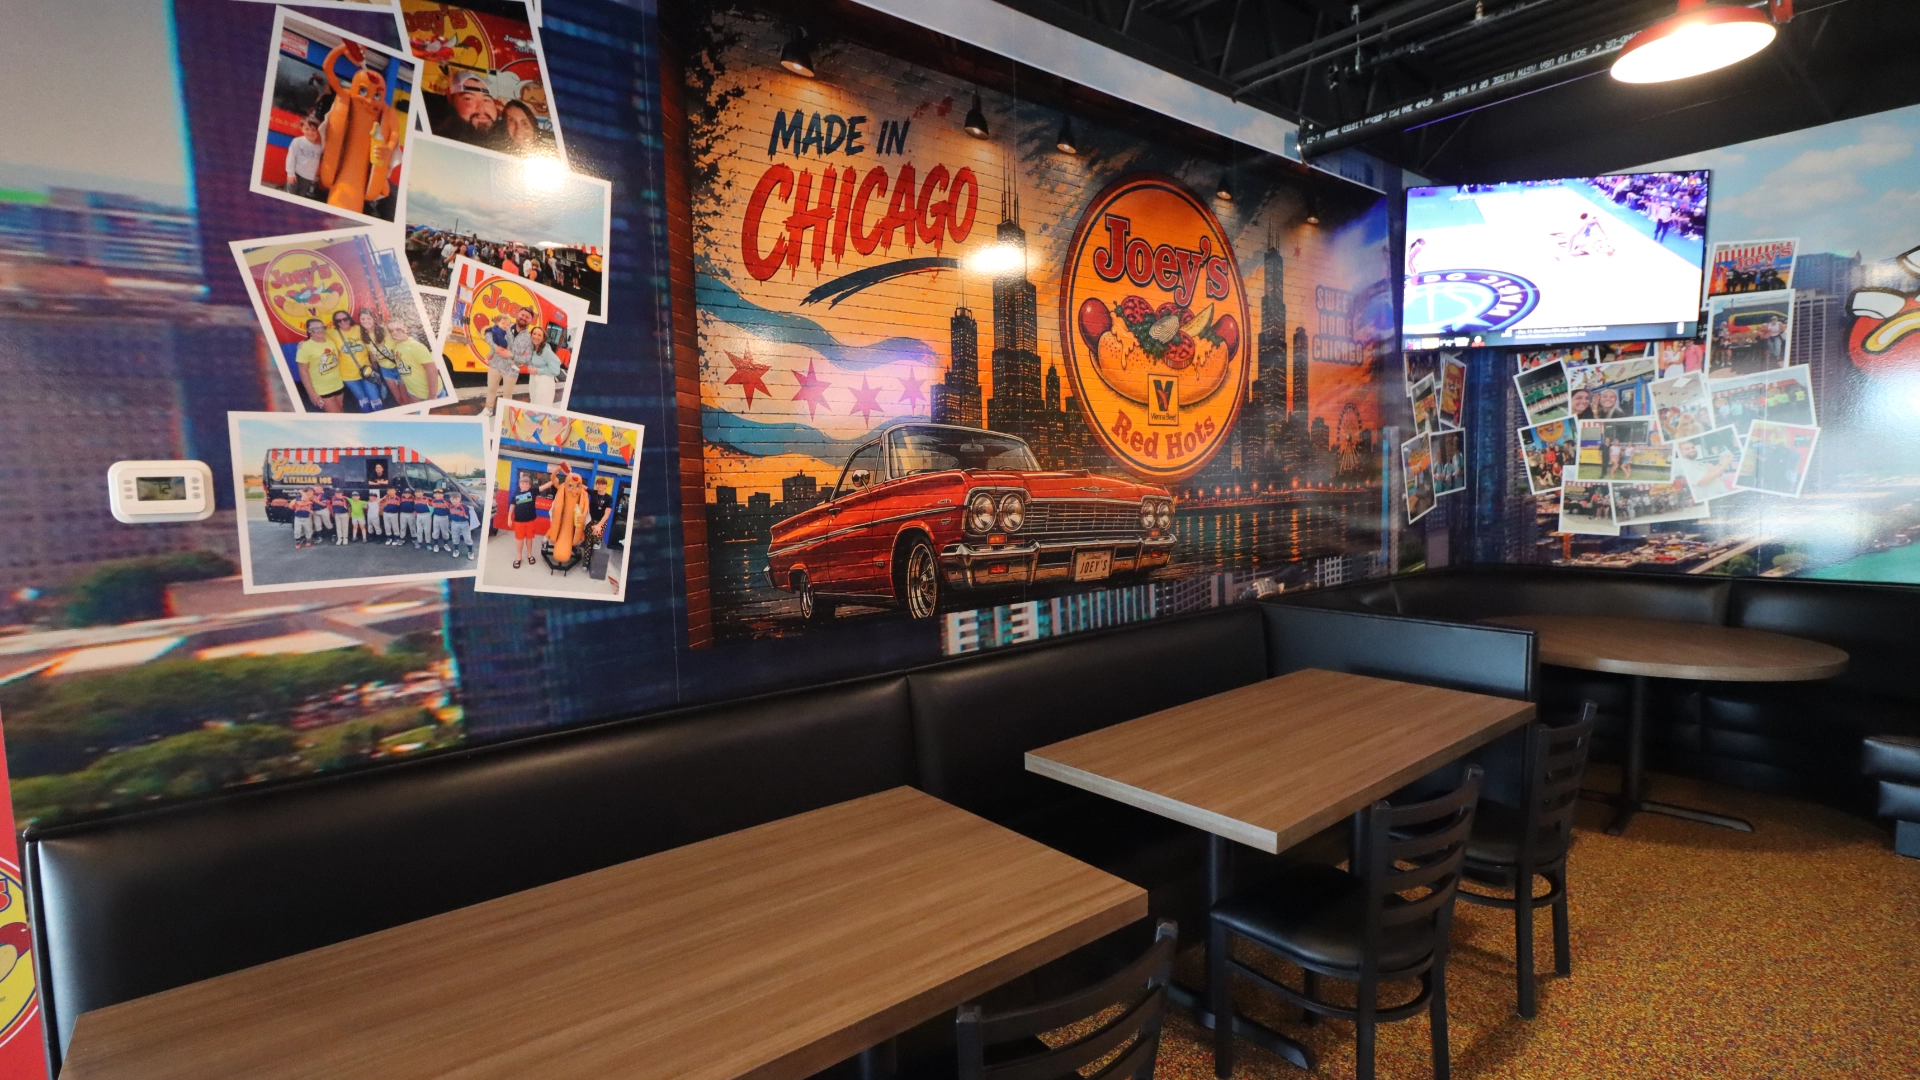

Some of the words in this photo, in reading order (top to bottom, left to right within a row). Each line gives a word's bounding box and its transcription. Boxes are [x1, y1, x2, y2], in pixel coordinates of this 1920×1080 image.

[404, 5, 468, 36] oey's
[1540, 58, 1554, 69] USA
[1571, 47, 1586, 59] SCH
[768, 109, 867, 159] MADE
[877, 117, 911, 156] IN
[742, 161, 979, 285] CHICAGO
[1094, 213, 1230, 308] Joey's
[1733, 244, 1793, 270] Joey's
[270, 260, 332, 289] Joey's
[1320, 314, 1352, 338] HOME
[1314, 338, 1362, 363] CHICAGO
[1111, 409, 1159, 460] Red
[1165, 416, 1216, 460] Hots
[1080, 560, 1108, 574] JOEY'S
